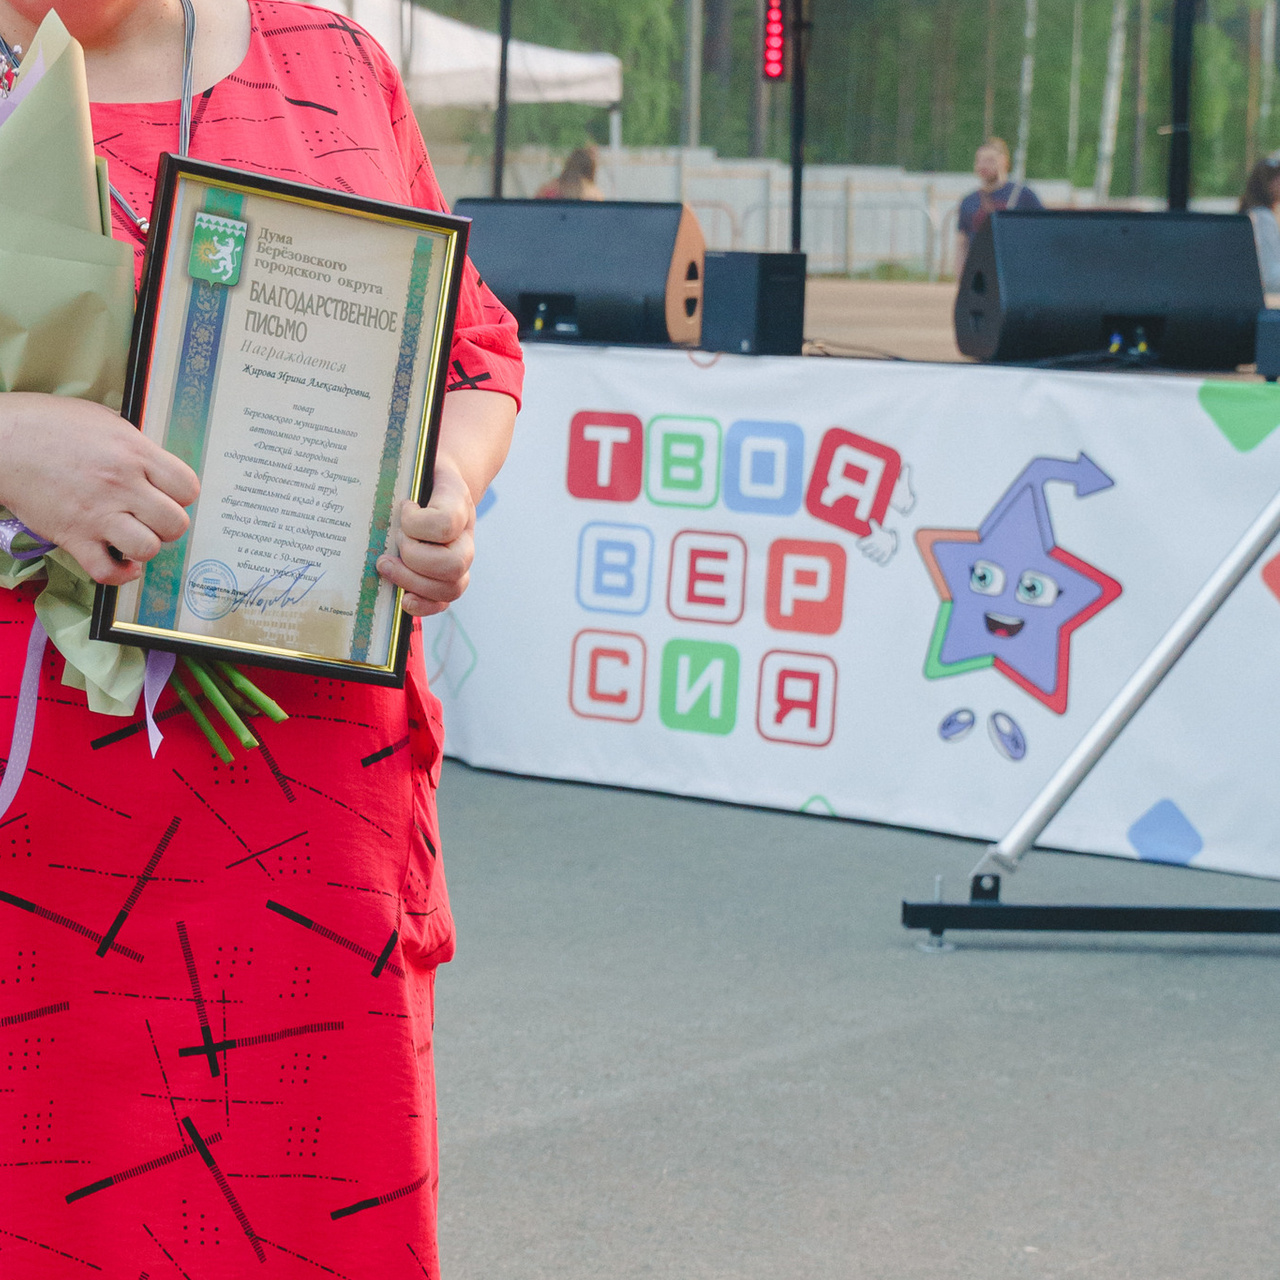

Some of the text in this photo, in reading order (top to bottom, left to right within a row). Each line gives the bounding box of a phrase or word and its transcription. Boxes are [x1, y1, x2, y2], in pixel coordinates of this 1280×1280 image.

[258, 227, 293, 245] Дума
[256, 241, 347, 272] Берёзовского
[254, 257, 383, 295] городского округа
[249, 280, 398, 332] БЛАГОДАРСТВЕННОЕ
[245, 309, 308, 342] ПИСЬМО
[240, 339, 346, 373] Награждается
[242, 363, 371, 400] Жирова Ирина Александровна,
[243, 407, 358, 438] Березовского муниципального
[292, 403, 315, 416] повар
[249, 425, 347, 451] автономного учреждения
[223, 450, 292, 471] оздоровительный
[293, 465, 319, 477] лагерь
[294, 449, 339, 465] загородный
[243, 470, 252, 478] за
[253, 470, 316, 491] добросовестный
[583, 424, 887, 522] ТВОЯ
[221, 495, 352, 528] общественного питания системы
[234, 483, 291, 501] значительный
[292, 495, 315, 506] вклад
[321, 500, 344, 513] сферу
[221, 511, 252, 525] отдыха
[252, 516, 276, 529] детей
[285, 525, 296, 534] их
[296, 527, 346, 542] оздоровления
[222, 526, 341, 557] Березовского городского округа
[237, 560, 270, 573] юбилеем
[250, 549, 272, 559] связи
[280, 553, 322, 568] 50-летним
[593, 539, 831, 617] ВЕР
[588, 647, 820, 728] СИЯ
